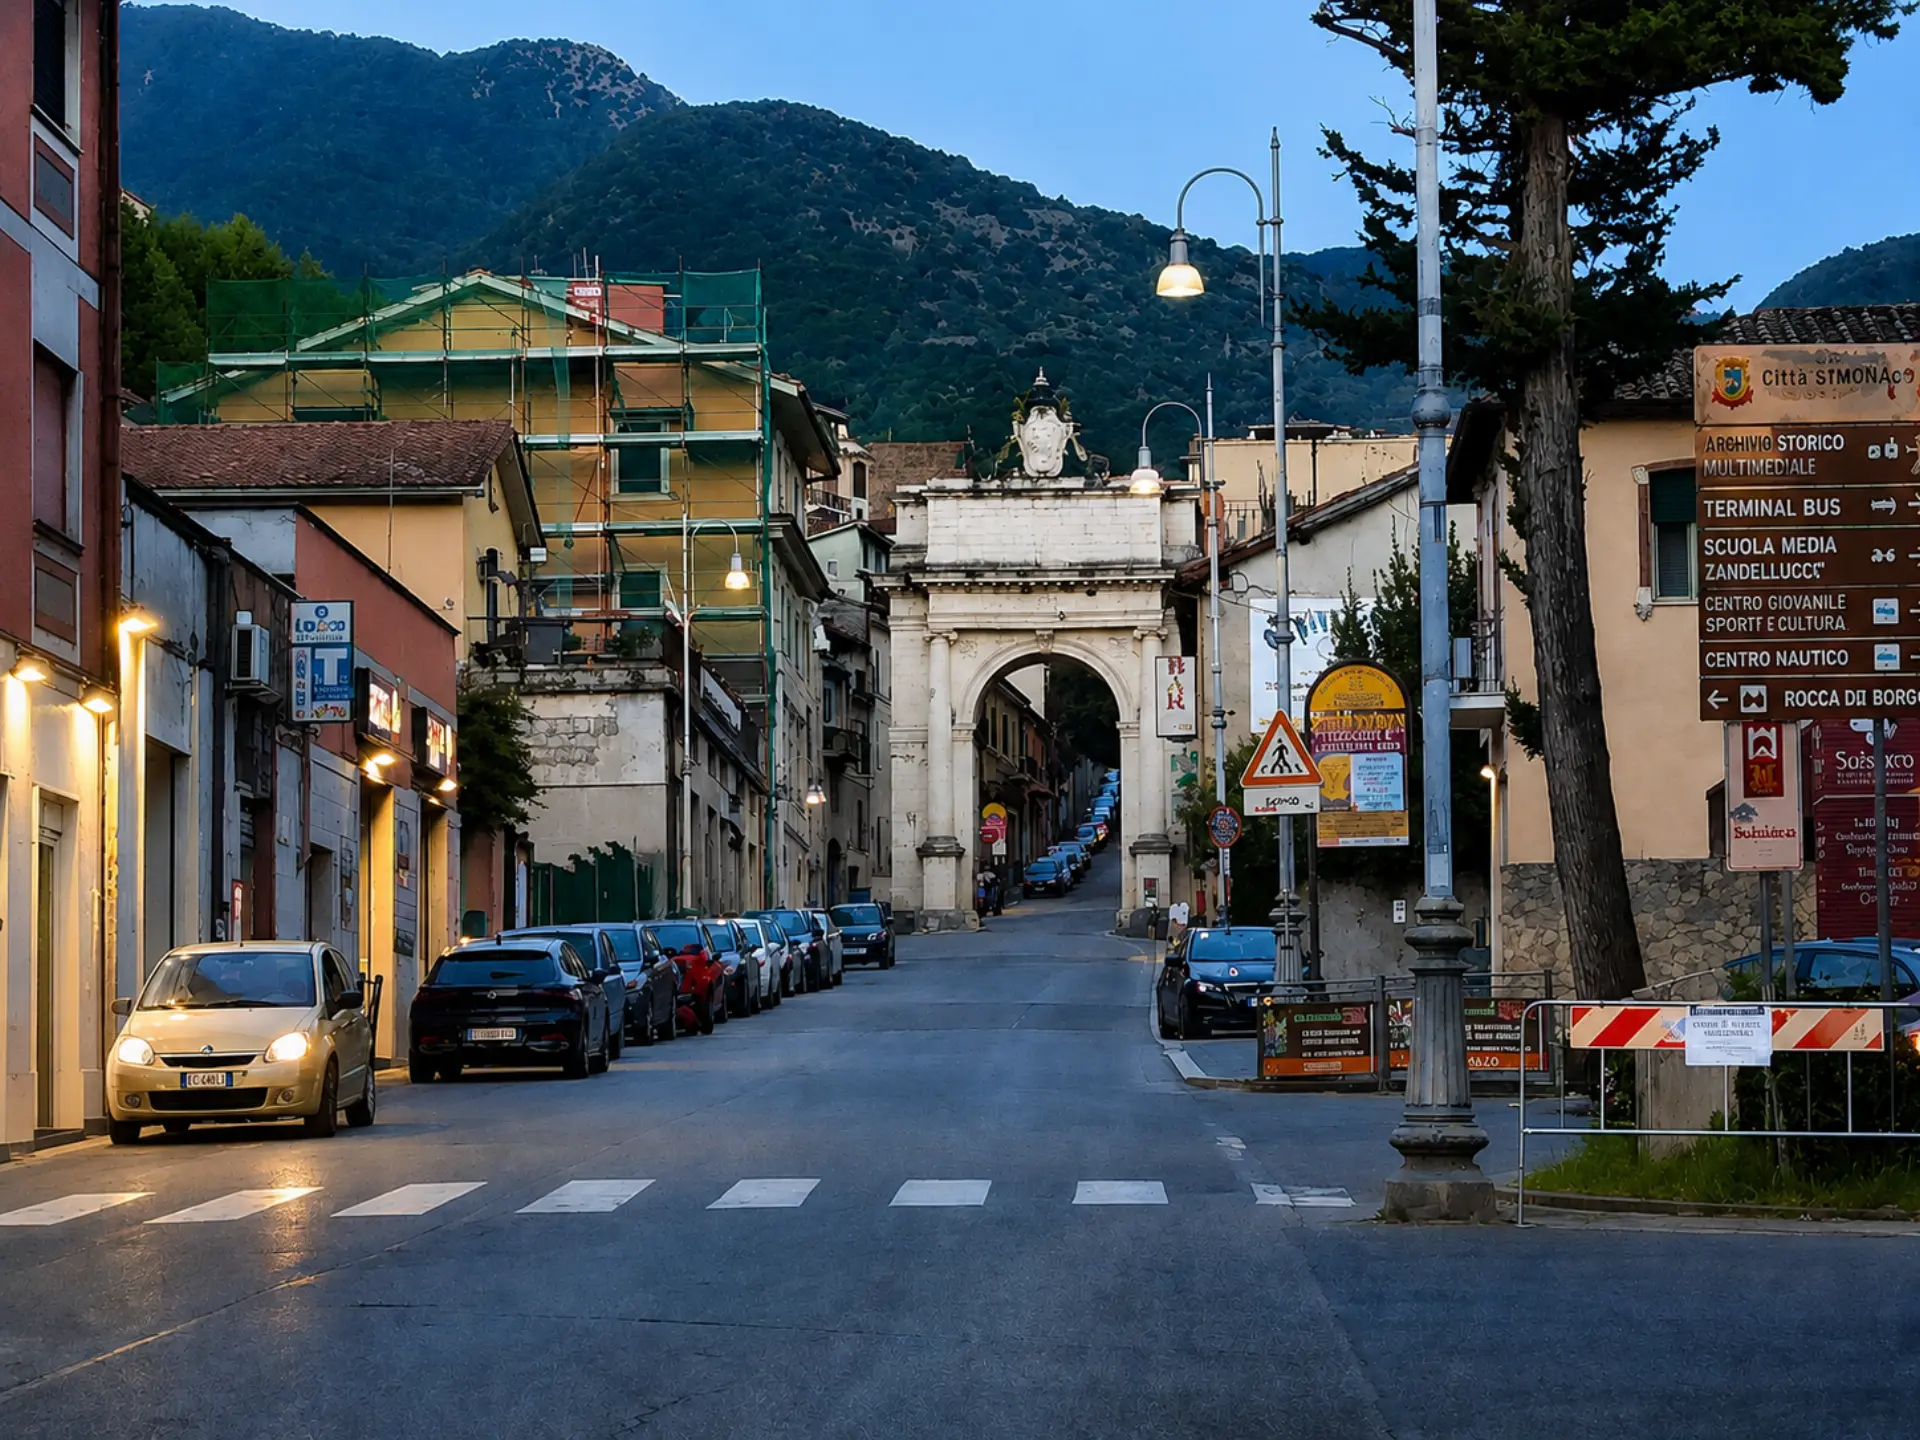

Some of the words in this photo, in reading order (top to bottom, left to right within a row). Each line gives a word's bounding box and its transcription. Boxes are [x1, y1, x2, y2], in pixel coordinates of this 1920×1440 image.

[1704, 435, 1772, 453] ARCHIVIO
[1777, 434, 1845, 451] STORICO
[1703, 457, 1816, 477] MULTIMEDIALE
[1703, 498, 1797, 518] TERMINAL
[1803, 497, 1841, 517] BUS
[1703, 536, 1775, 556] SCUOLA
[1781, 535, 1837, 555] MEDIA
[1704, 595, 1763, 612] CENTRO
[1767, 593, 1846, 611] GIOVANILE
[1777, 614, 1846, 631] CULTURA
[1704, 650, 1771, 668] CENTRO
[1775, 649, 1849, 667] NAUTICO
[1783, 689, 1841, 708] ROCCA
[1872, 688, 1920, 706] BORG
